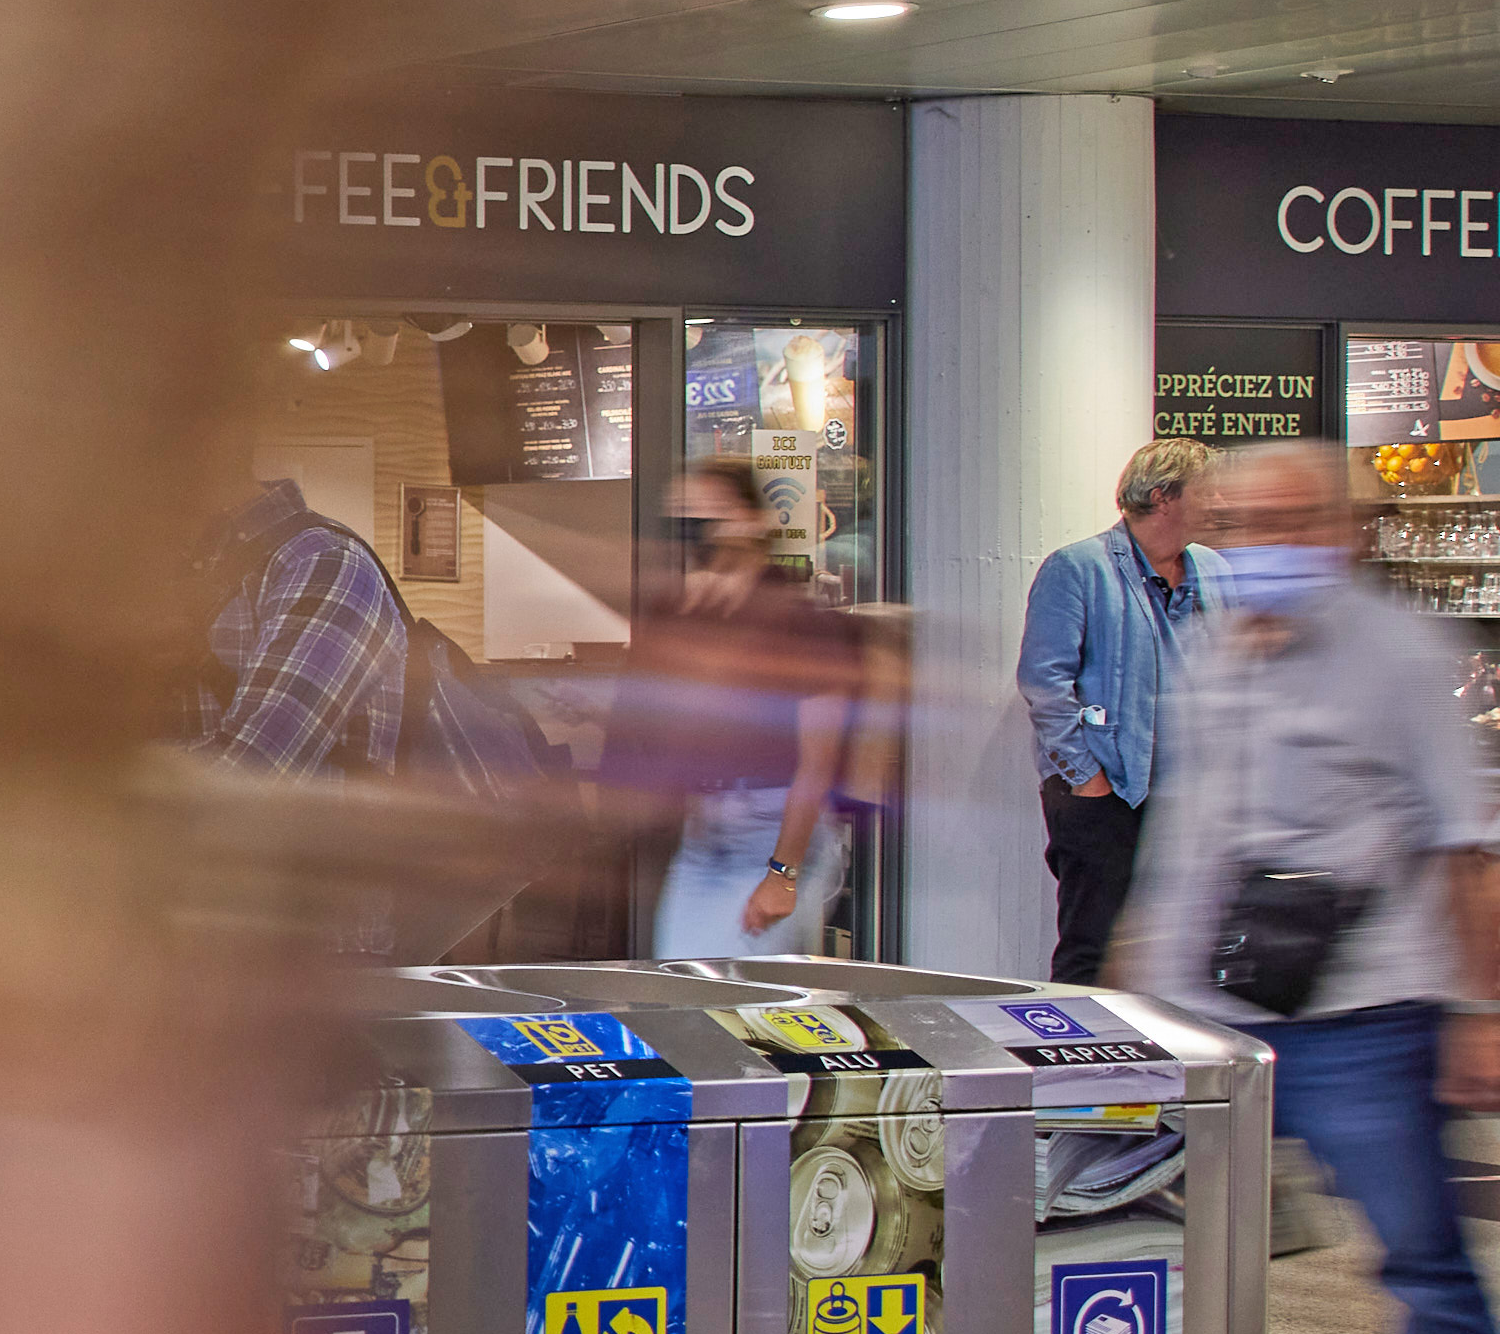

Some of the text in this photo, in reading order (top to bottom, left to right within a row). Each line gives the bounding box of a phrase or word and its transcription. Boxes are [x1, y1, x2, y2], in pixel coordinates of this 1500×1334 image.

[294, 151, 756, 237] FEE&FRIENDS
[1277, 185, 1500, 258] COFFE
[1154, 366, 1315, 399] PPRÉCIEZ UN
[1153, 404, 1301, 436] CAFÉ ENTRE
[772, 435, 797, 451] ICI
[819, 1053, 880, 1070] ALU
[1036, 1044, 1147, 1063] PAPIER
[565, 1063, 622, 1079] PET
